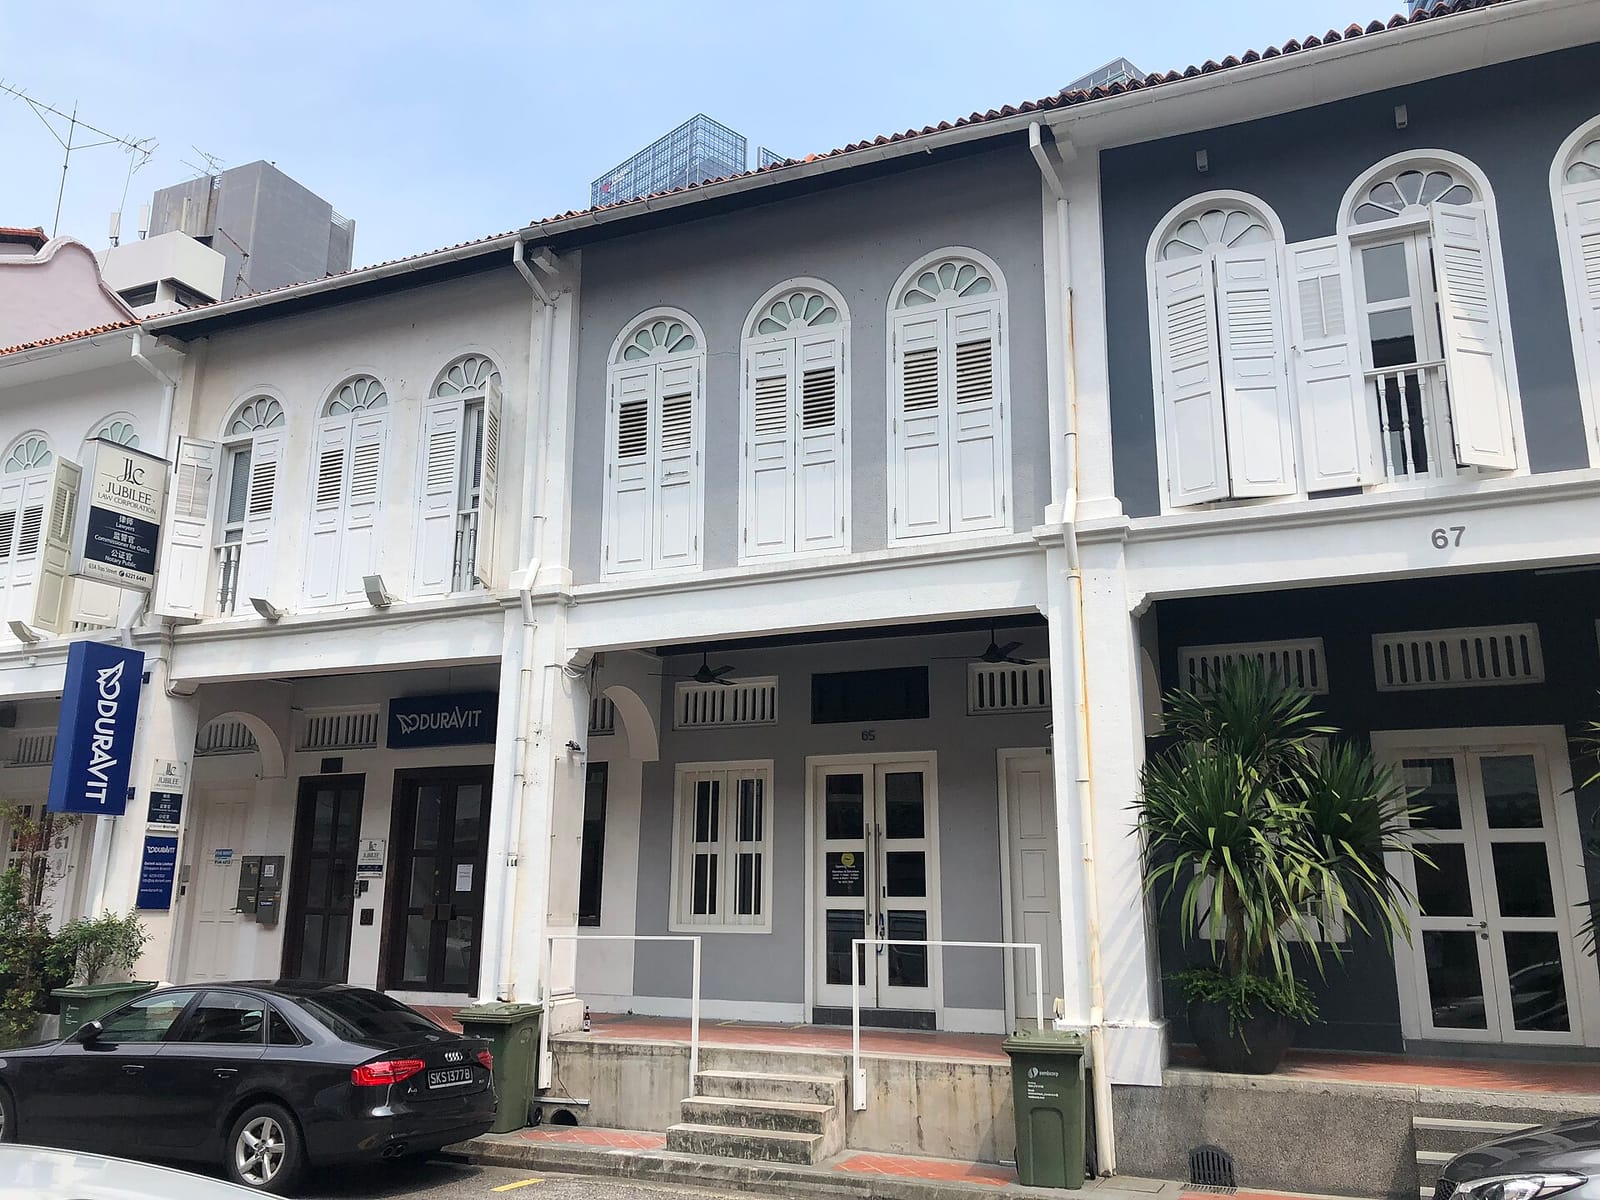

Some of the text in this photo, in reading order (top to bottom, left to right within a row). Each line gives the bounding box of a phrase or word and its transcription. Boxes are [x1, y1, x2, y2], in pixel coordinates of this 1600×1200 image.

[116, 457, 145, 486] JLC
[97, 492, 157, 515] LAW CORPORATION
[105, 482, 152, 505] JUBILEE
[115, 522, 135, 532] Lawyers
[1431, 526, 1466, 549] 67
[94, 534, 129, 548] Commissioner
[136, 545, 150, 554] Oaths
[104, 555, 137, 569] Notary Public
[420, 706, 482, 730] DURAVIT
[861, 730, 876, 741] 65
[85, 700, 118, 804] DURAVIT
[54, 836, 69, 849] 61
[430, 1068, 471, 1084] SKS1377B
